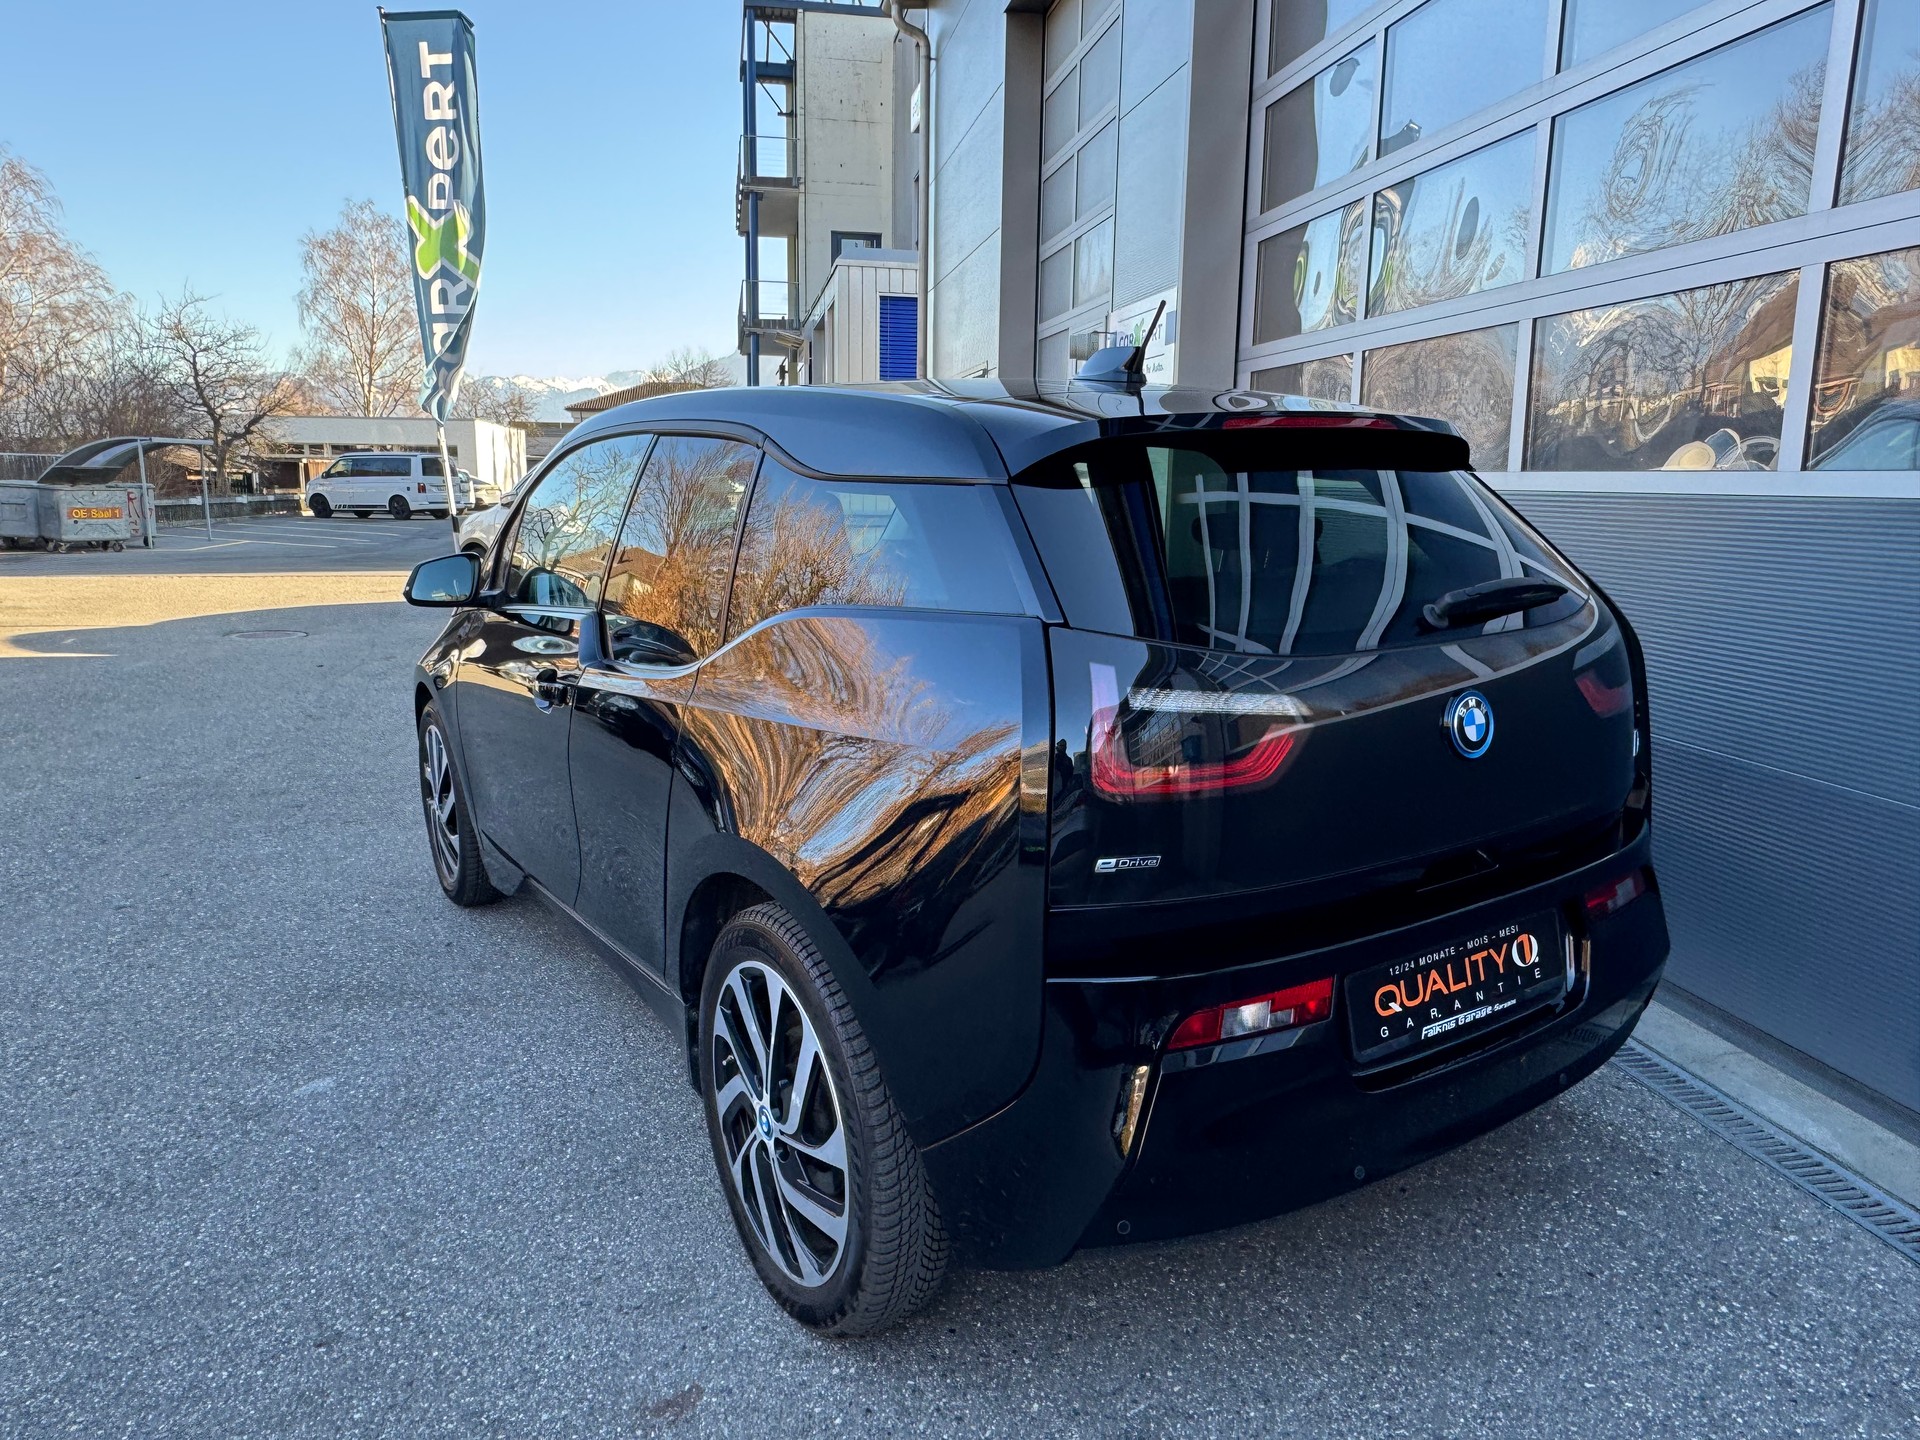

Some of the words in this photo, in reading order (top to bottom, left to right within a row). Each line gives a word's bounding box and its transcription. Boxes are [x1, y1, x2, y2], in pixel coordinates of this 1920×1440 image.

[72, 508, 87, 518] OE
[114, 509, 120, 518] 1
[1458, 698, 1487, 717] BMW
[1389, 959, 1415, 976] 12/24
[1419, 946, 1456, 966] MONATE
[1466, 935, 1489, 950] MOIS
[1499, 924, 1519, 937] MESI
[1374, 943, 1508, 1017] QUALITY
[1421, 1018, 1457, 1040] Falknis
[1458, 1005, 1493, 1026] Garage
